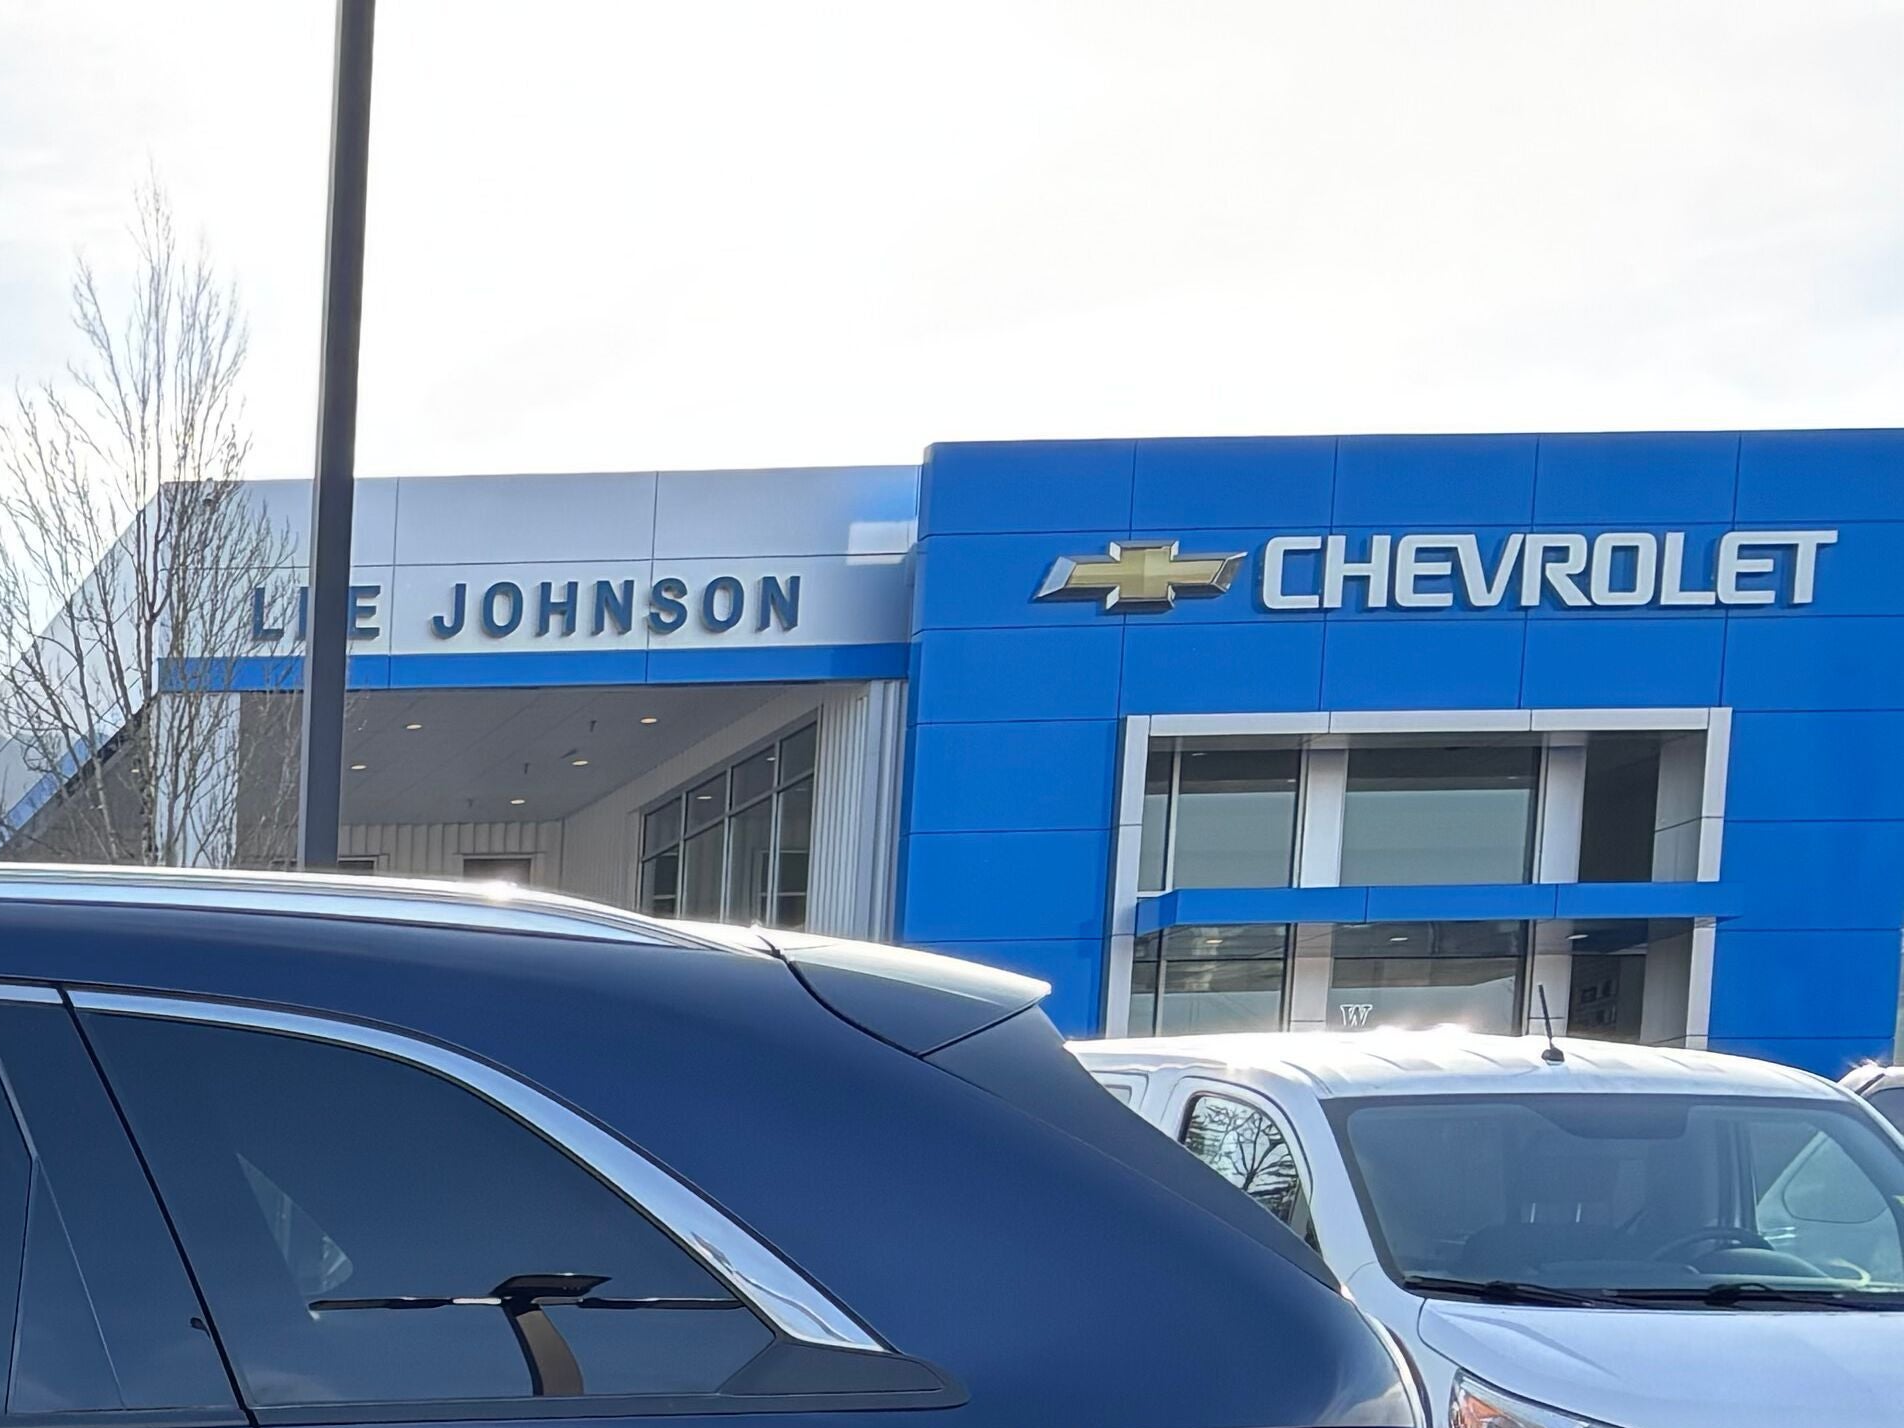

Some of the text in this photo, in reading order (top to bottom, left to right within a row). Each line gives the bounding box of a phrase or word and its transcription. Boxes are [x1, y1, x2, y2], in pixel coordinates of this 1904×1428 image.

[1262, 530, 1838, 609] CHEVROLET
[251, 574, 801, 642] LE JOHNSON
